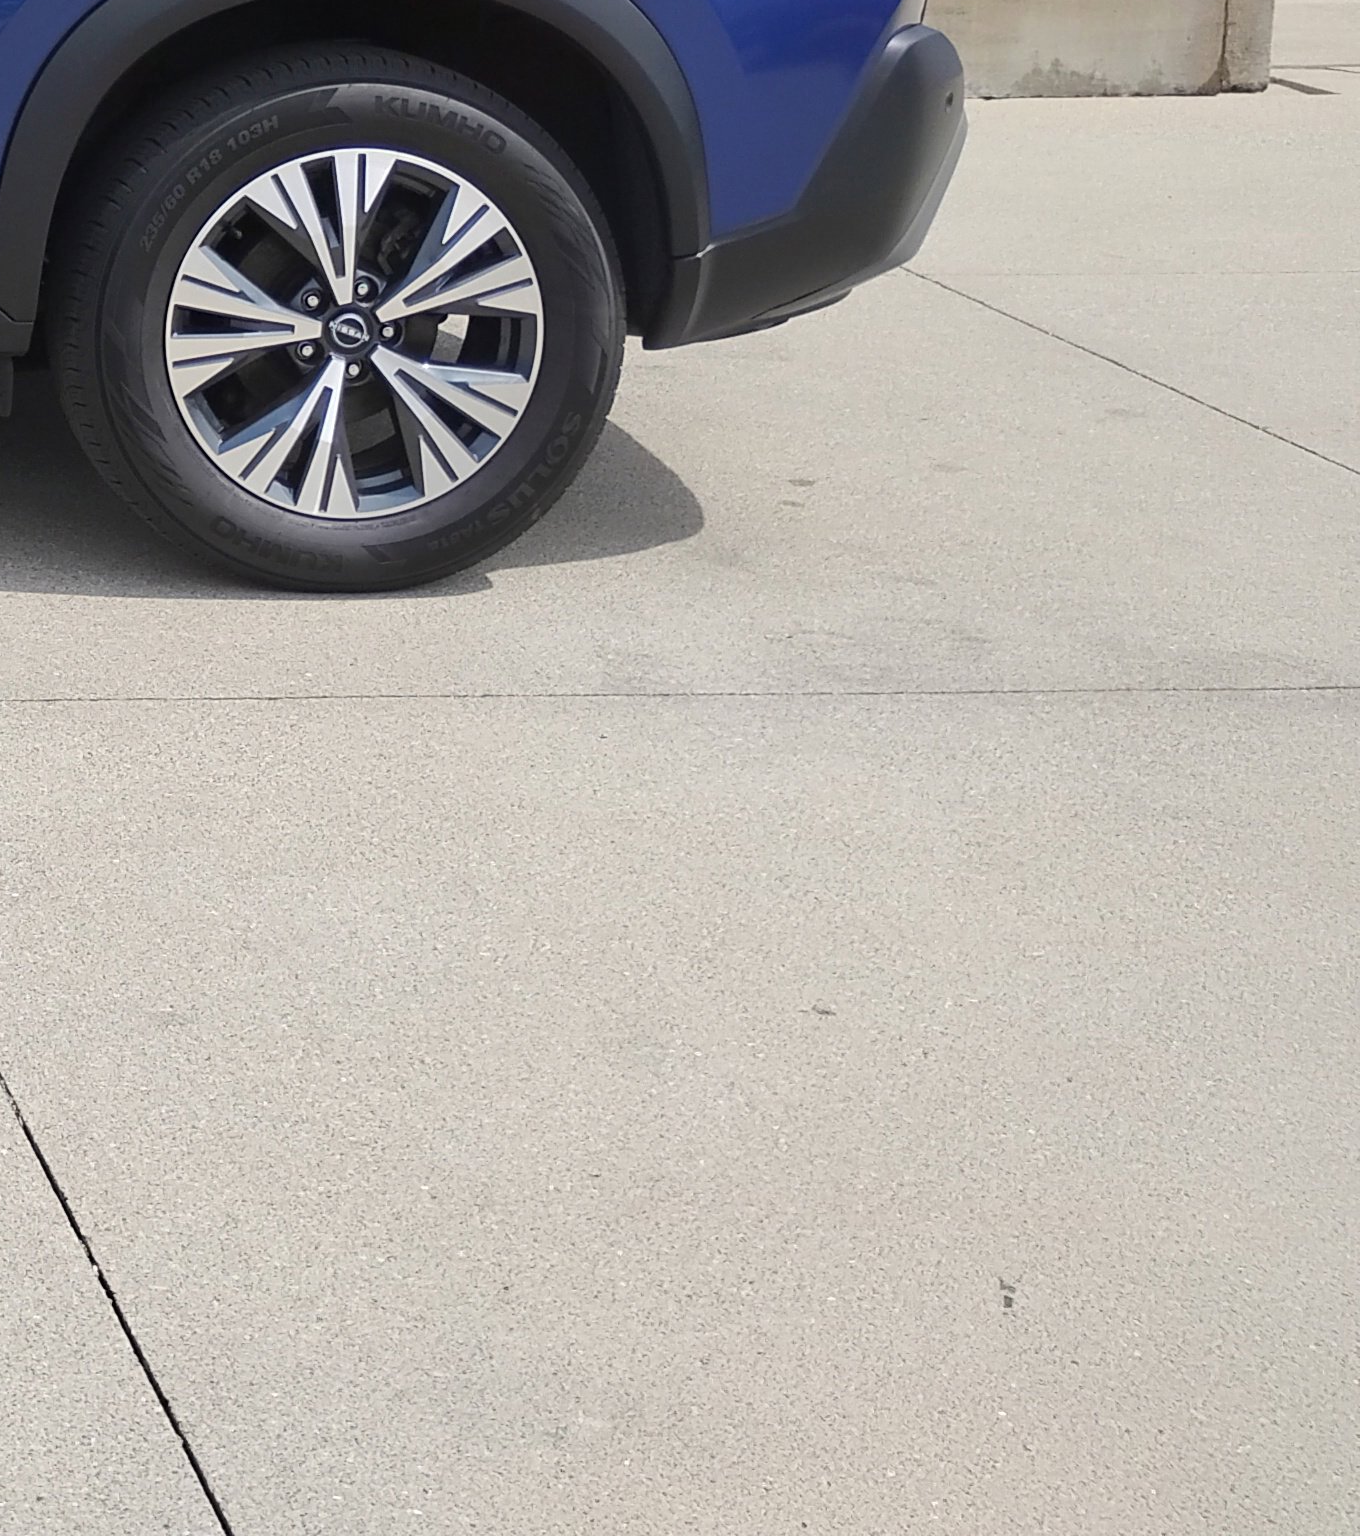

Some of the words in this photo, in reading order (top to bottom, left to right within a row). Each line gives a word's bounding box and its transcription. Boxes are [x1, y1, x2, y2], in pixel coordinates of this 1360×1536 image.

[374, 94, 509, 155] KUMHO
[139, 184, 186, 252] 235/60
[187, 148, 223, 186] R18
[226, 115, 279, 152] 103H
[328, 320, 370, 342] NISSAN
[484, 410, 582, 524] SOLUS
[209, 515, 343, 573] KUMHO
